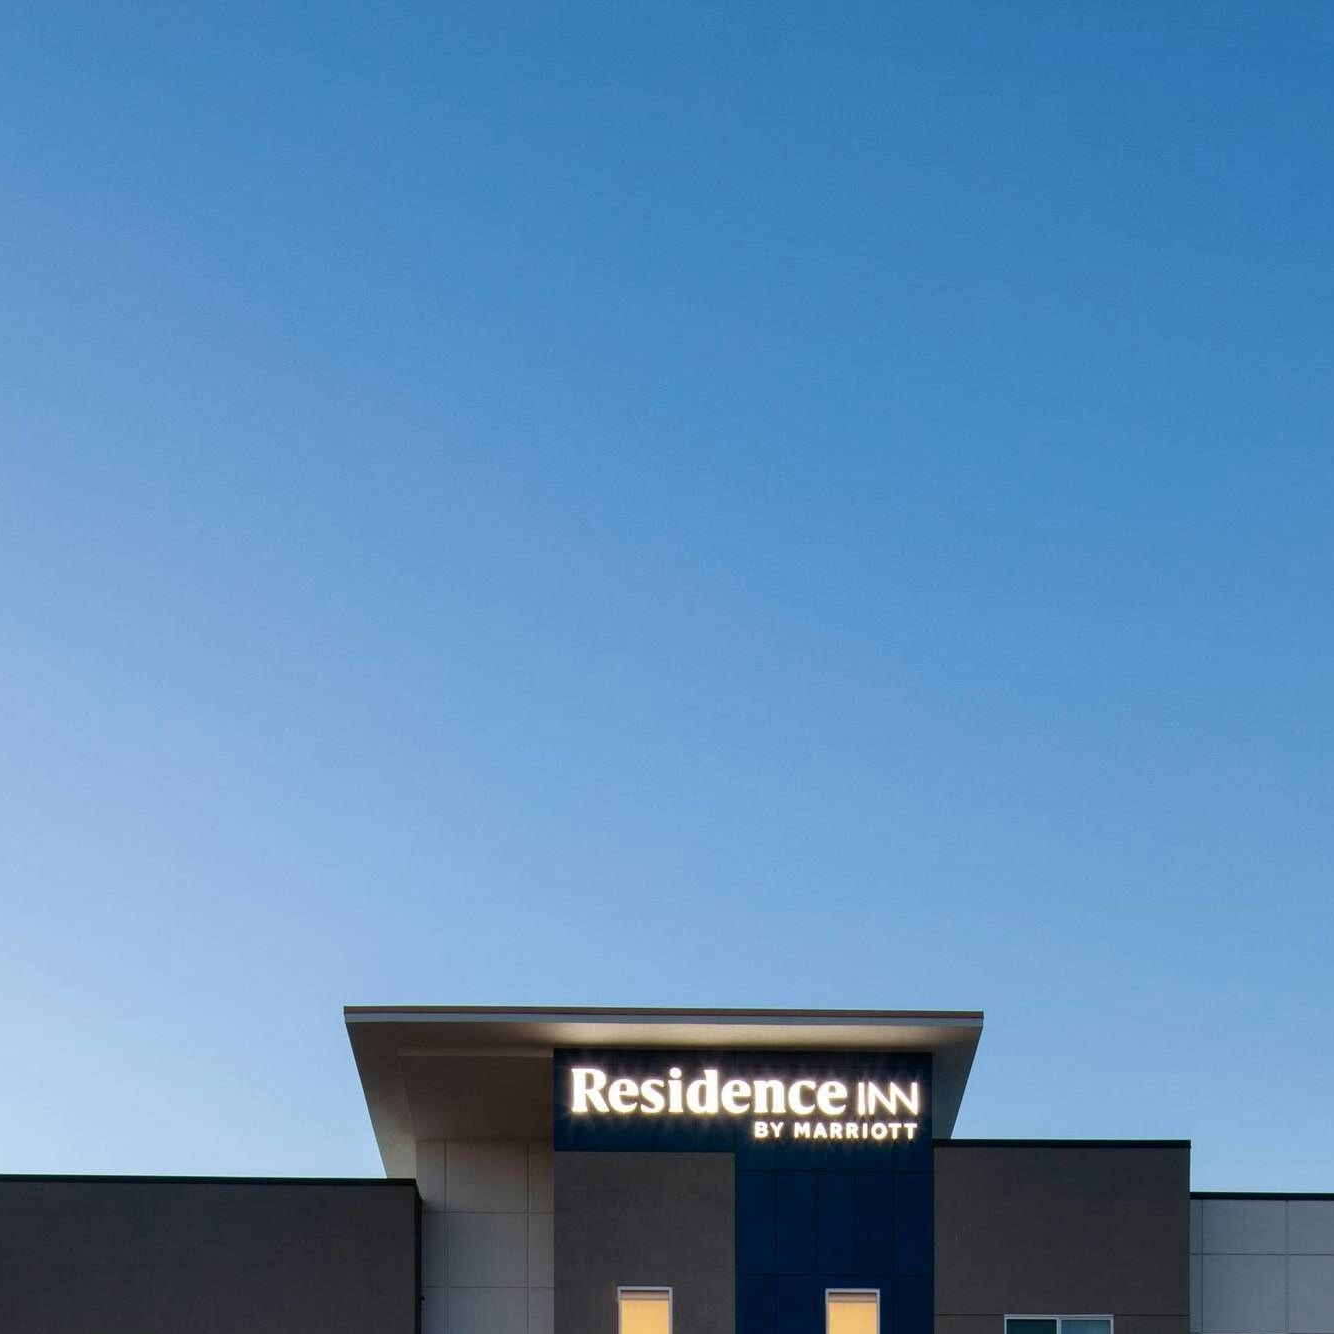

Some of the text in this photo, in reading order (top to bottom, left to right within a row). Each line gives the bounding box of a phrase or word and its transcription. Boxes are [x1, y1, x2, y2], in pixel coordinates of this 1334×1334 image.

[571, 1067, 919, 1116] Residence INN
[753, 1121, 918, 1140] BY MARRIOTT
